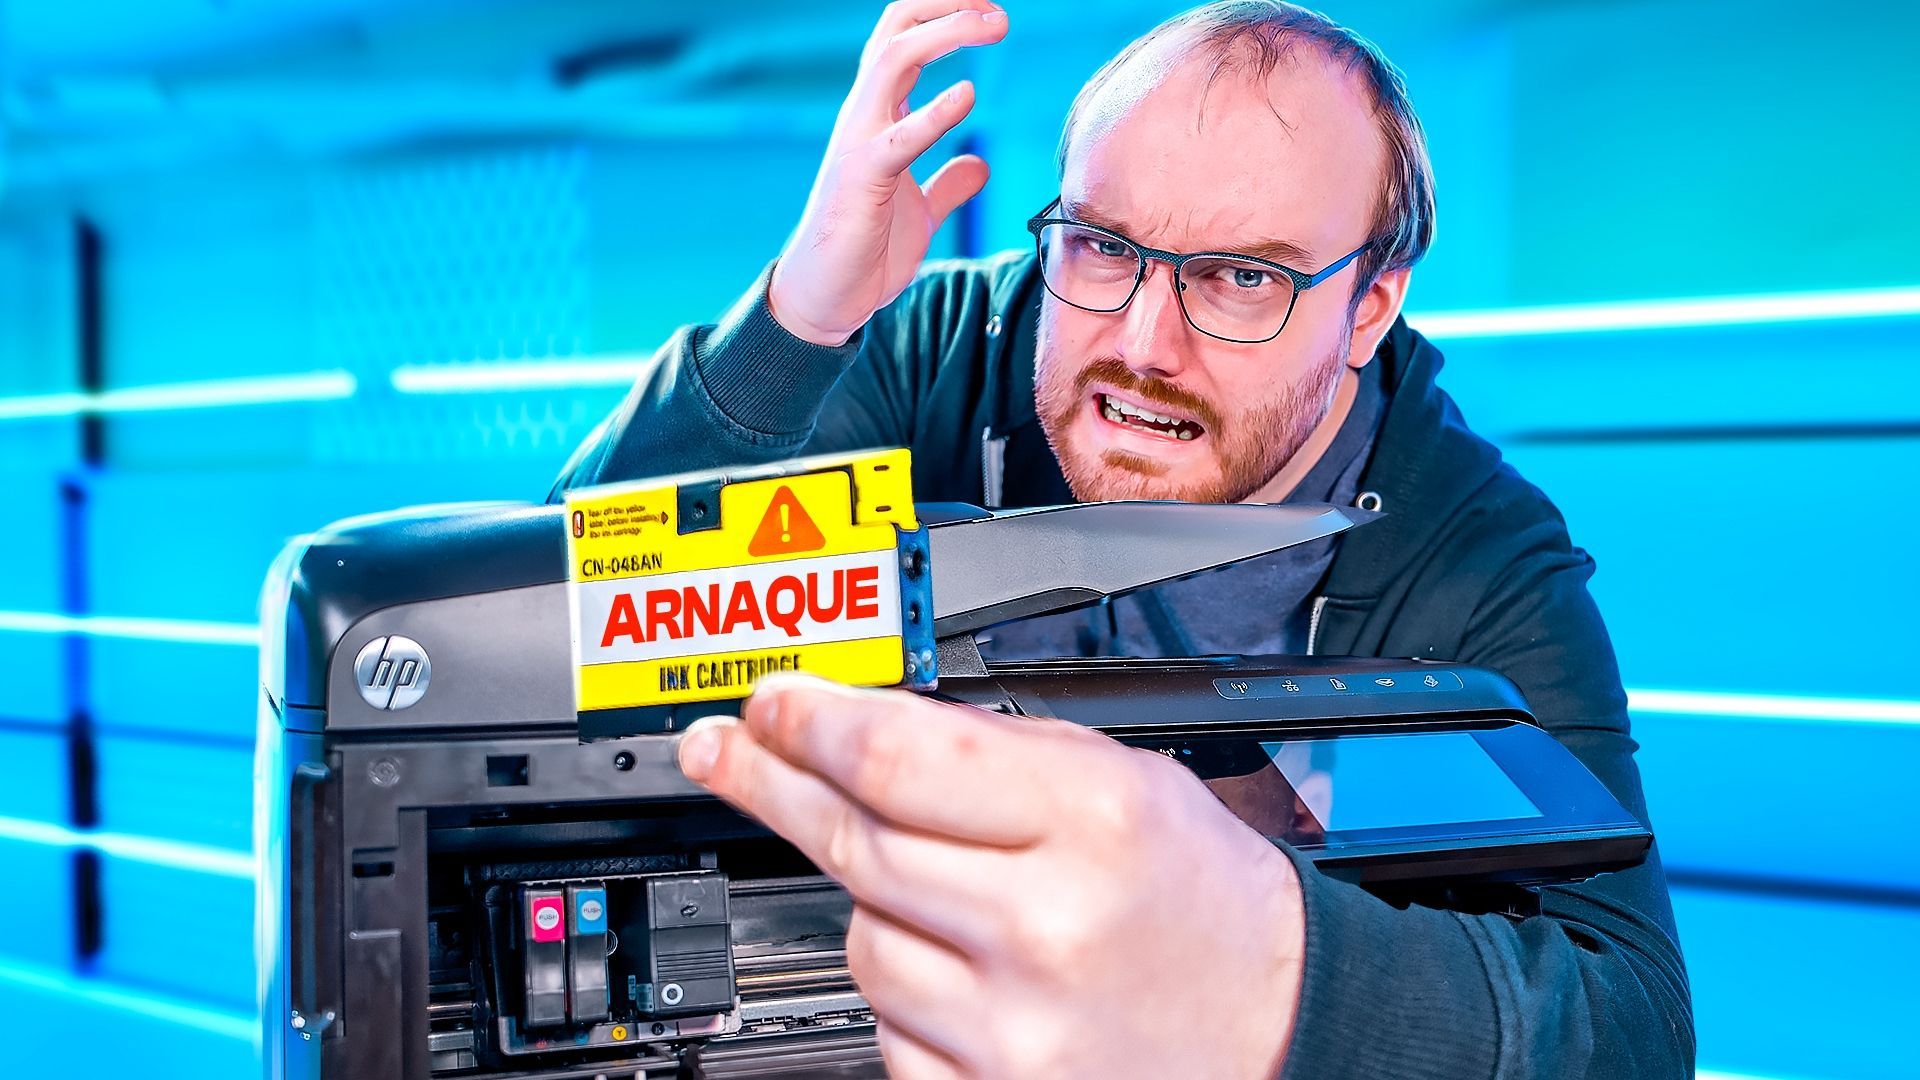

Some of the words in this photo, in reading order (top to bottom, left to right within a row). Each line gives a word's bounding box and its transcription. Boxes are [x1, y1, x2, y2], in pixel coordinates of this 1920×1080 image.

[600, 566, 879, 647] ARNAQUE
[363, 636, 425, 709] hp
[659, 664, 691, 692] INK
